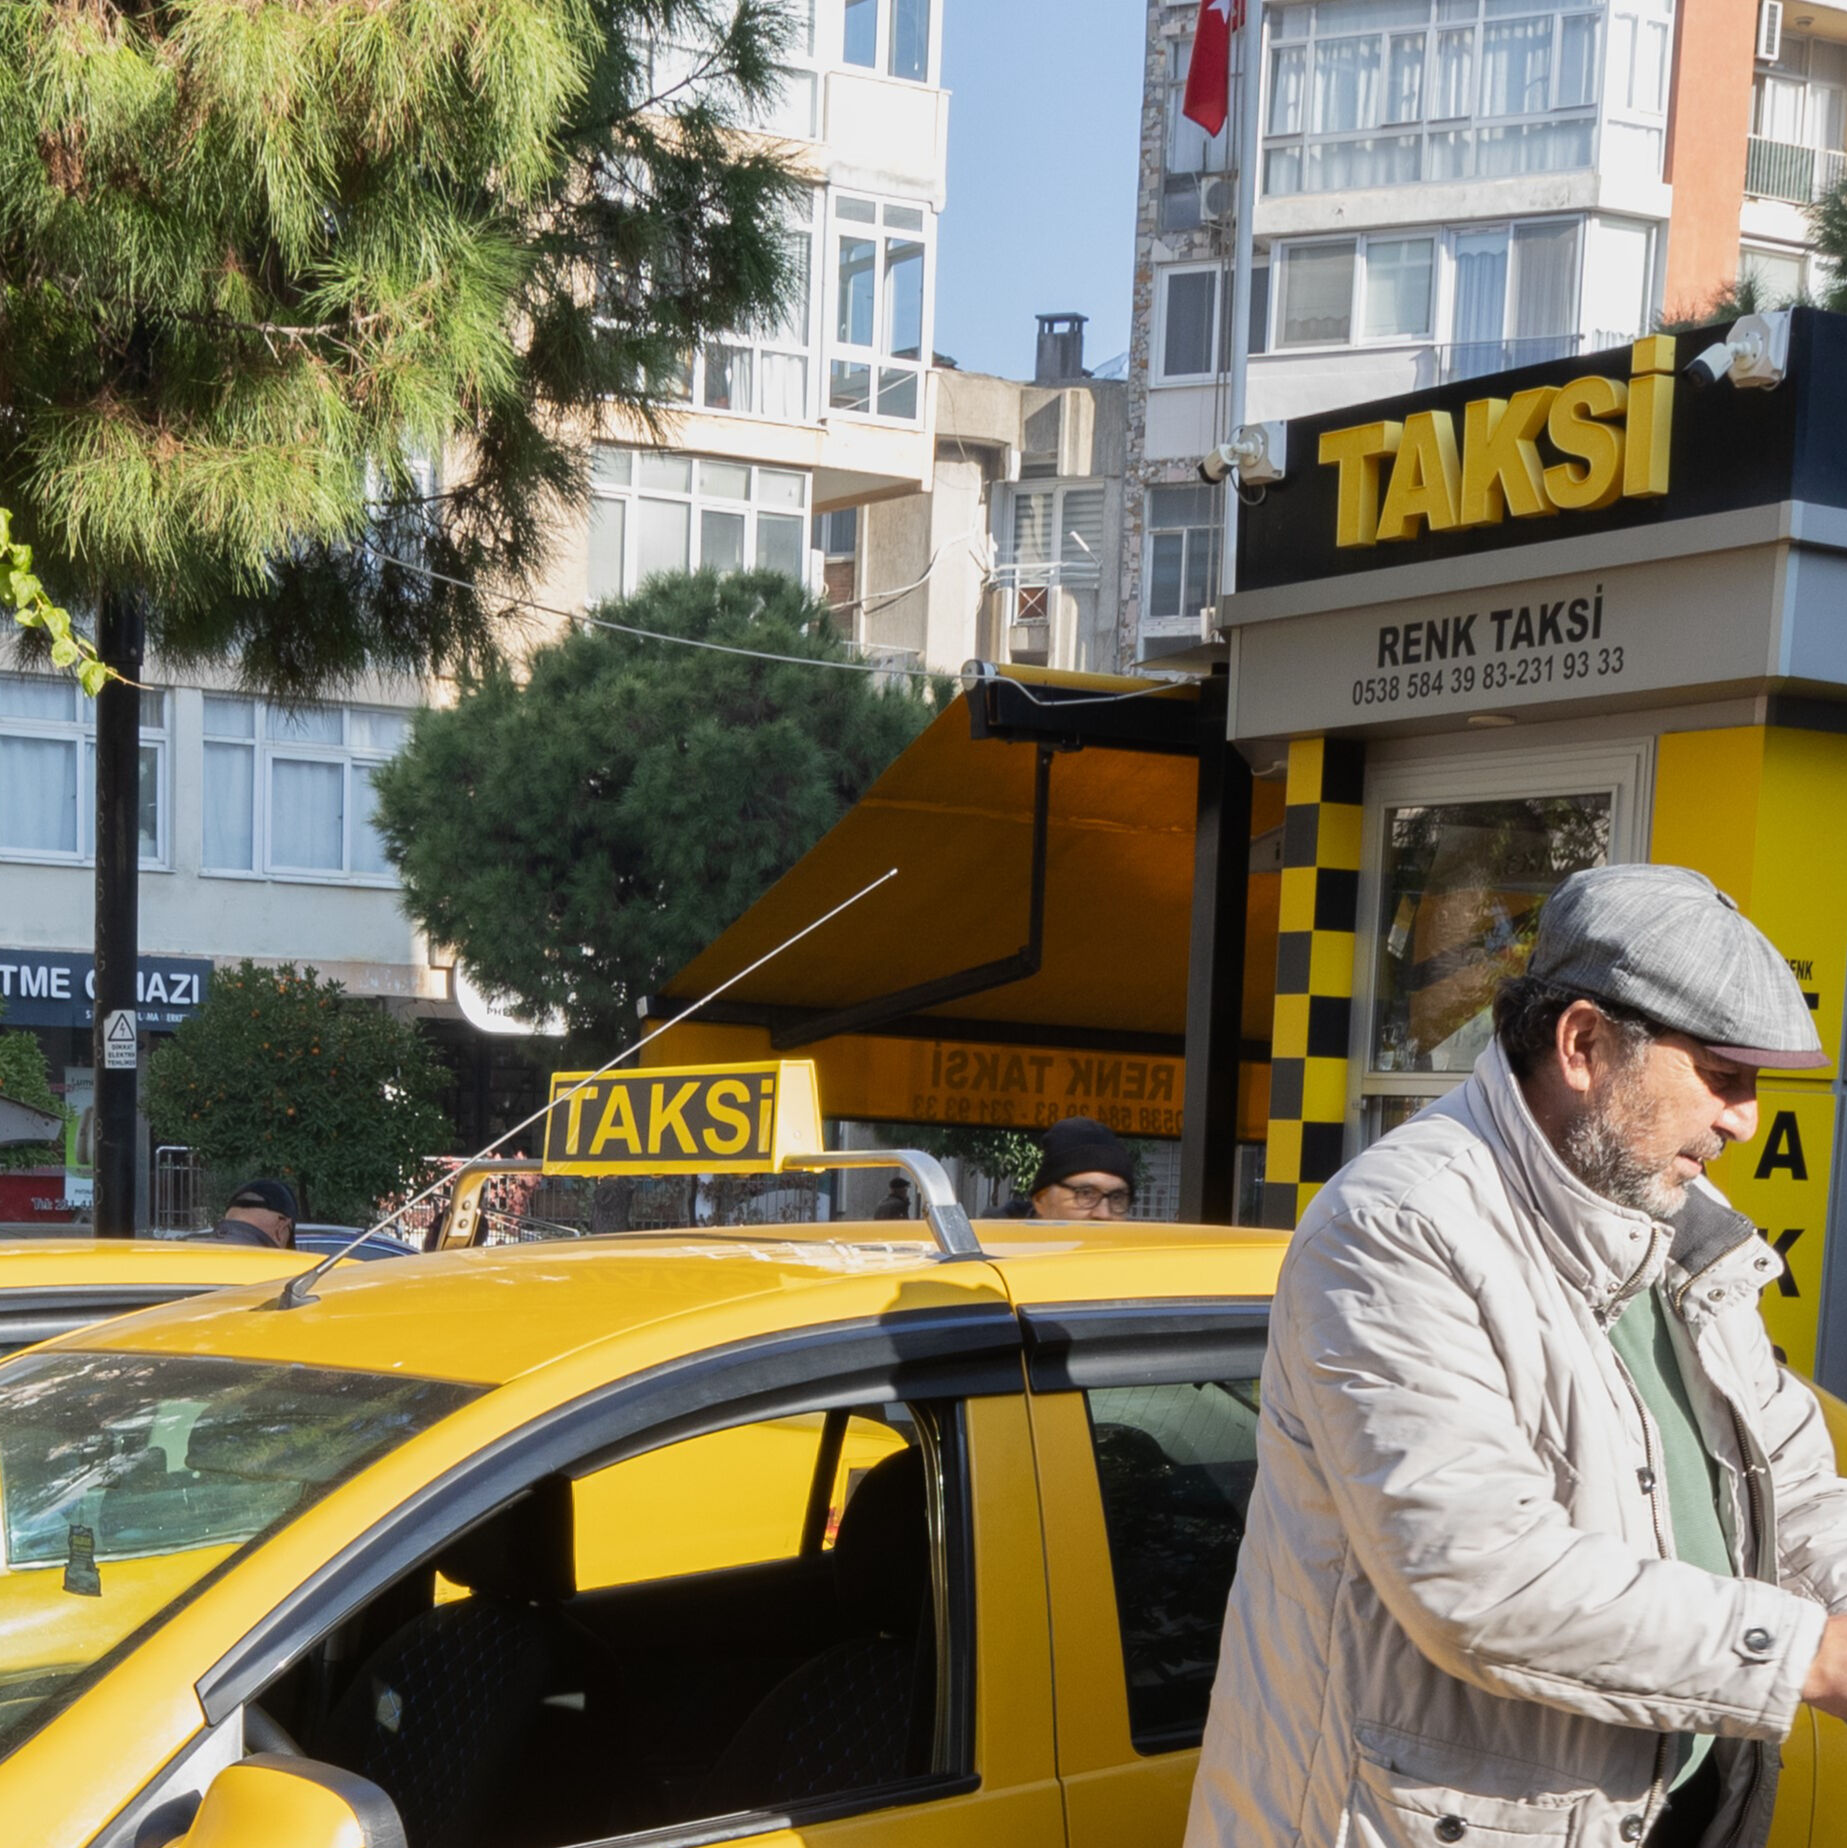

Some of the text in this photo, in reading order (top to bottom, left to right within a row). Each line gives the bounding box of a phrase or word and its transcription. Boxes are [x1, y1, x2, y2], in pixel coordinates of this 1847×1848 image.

[1318, 334, 1677, 549] TAKSİ
[1377, 584, 1605, 669] RENK TAKSİ
[1353, 645, 1625, 706] 0538 584 39 83-231 93 33
[1786, 959, 1813, 982] ENK
